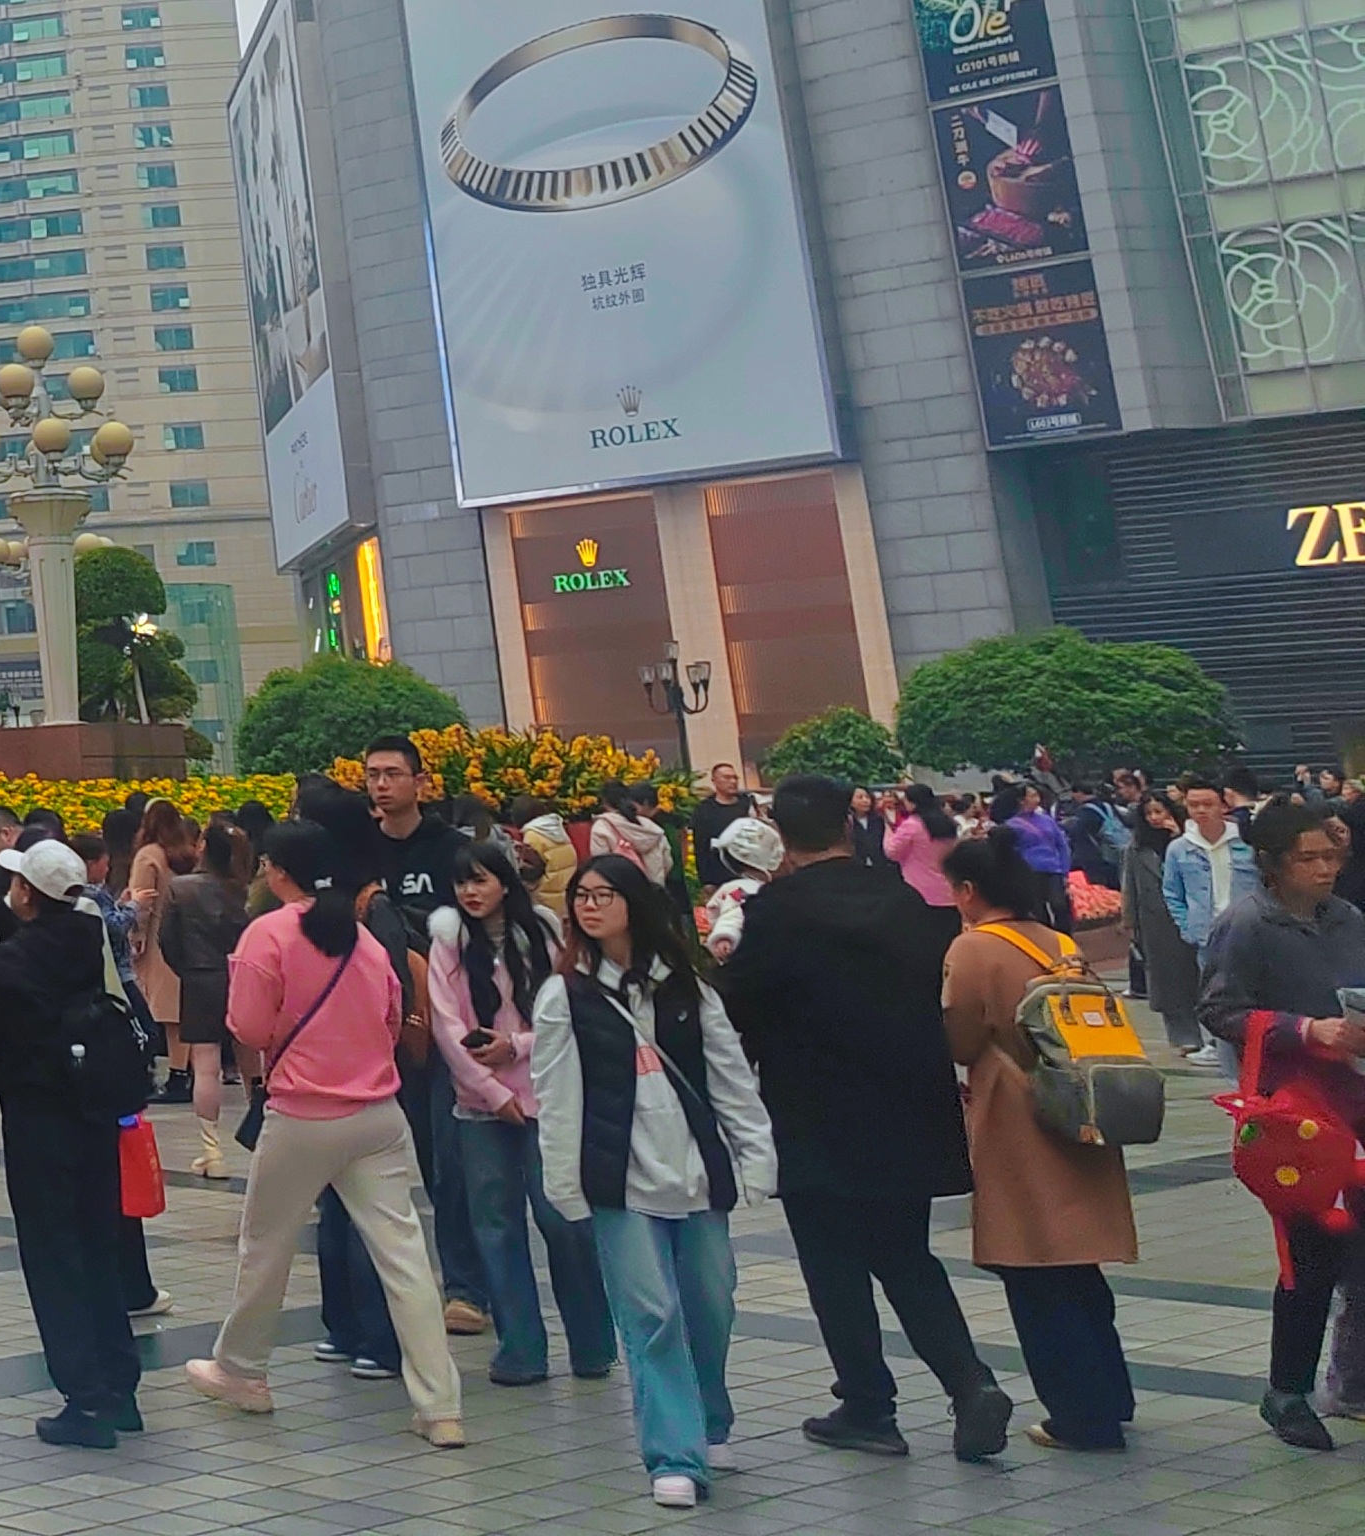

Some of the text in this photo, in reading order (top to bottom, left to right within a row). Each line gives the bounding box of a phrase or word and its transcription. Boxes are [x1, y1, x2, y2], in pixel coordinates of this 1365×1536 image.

[581, 263, 647, 292] 独具光辉
[589, 418, 682, 449] ROLEX
[552, 569, 631, 593] ROLEX
